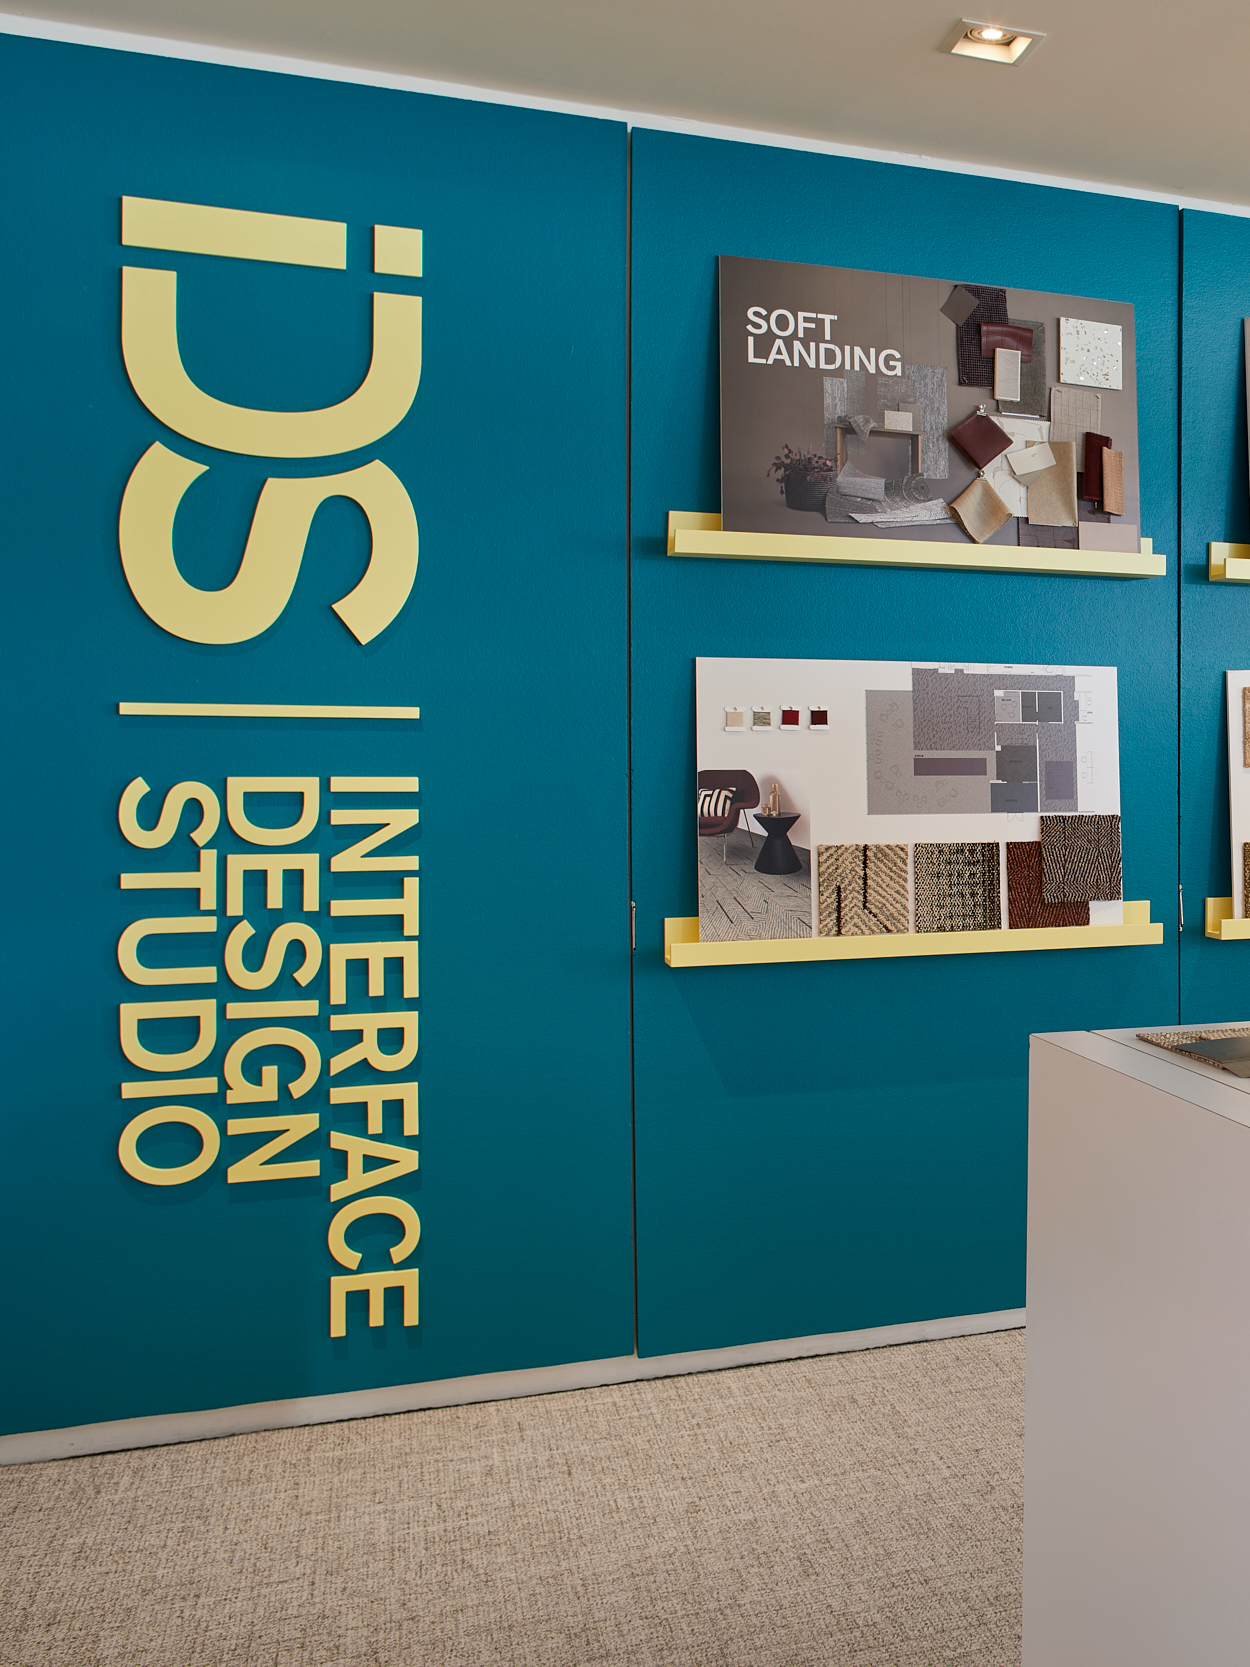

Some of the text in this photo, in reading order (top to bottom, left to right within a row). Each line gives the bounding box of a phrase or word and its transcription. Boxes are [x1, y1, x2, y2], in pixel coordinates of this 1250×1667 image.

[746, 306, 838, 341] SOFT
[747, 336, 902, 377] LANDING
[117, 776, 221, 1186] STUDIO
[223, 776, 323, 1184] DESIGN
[327, 776, 421, 1338] INTERFACE
